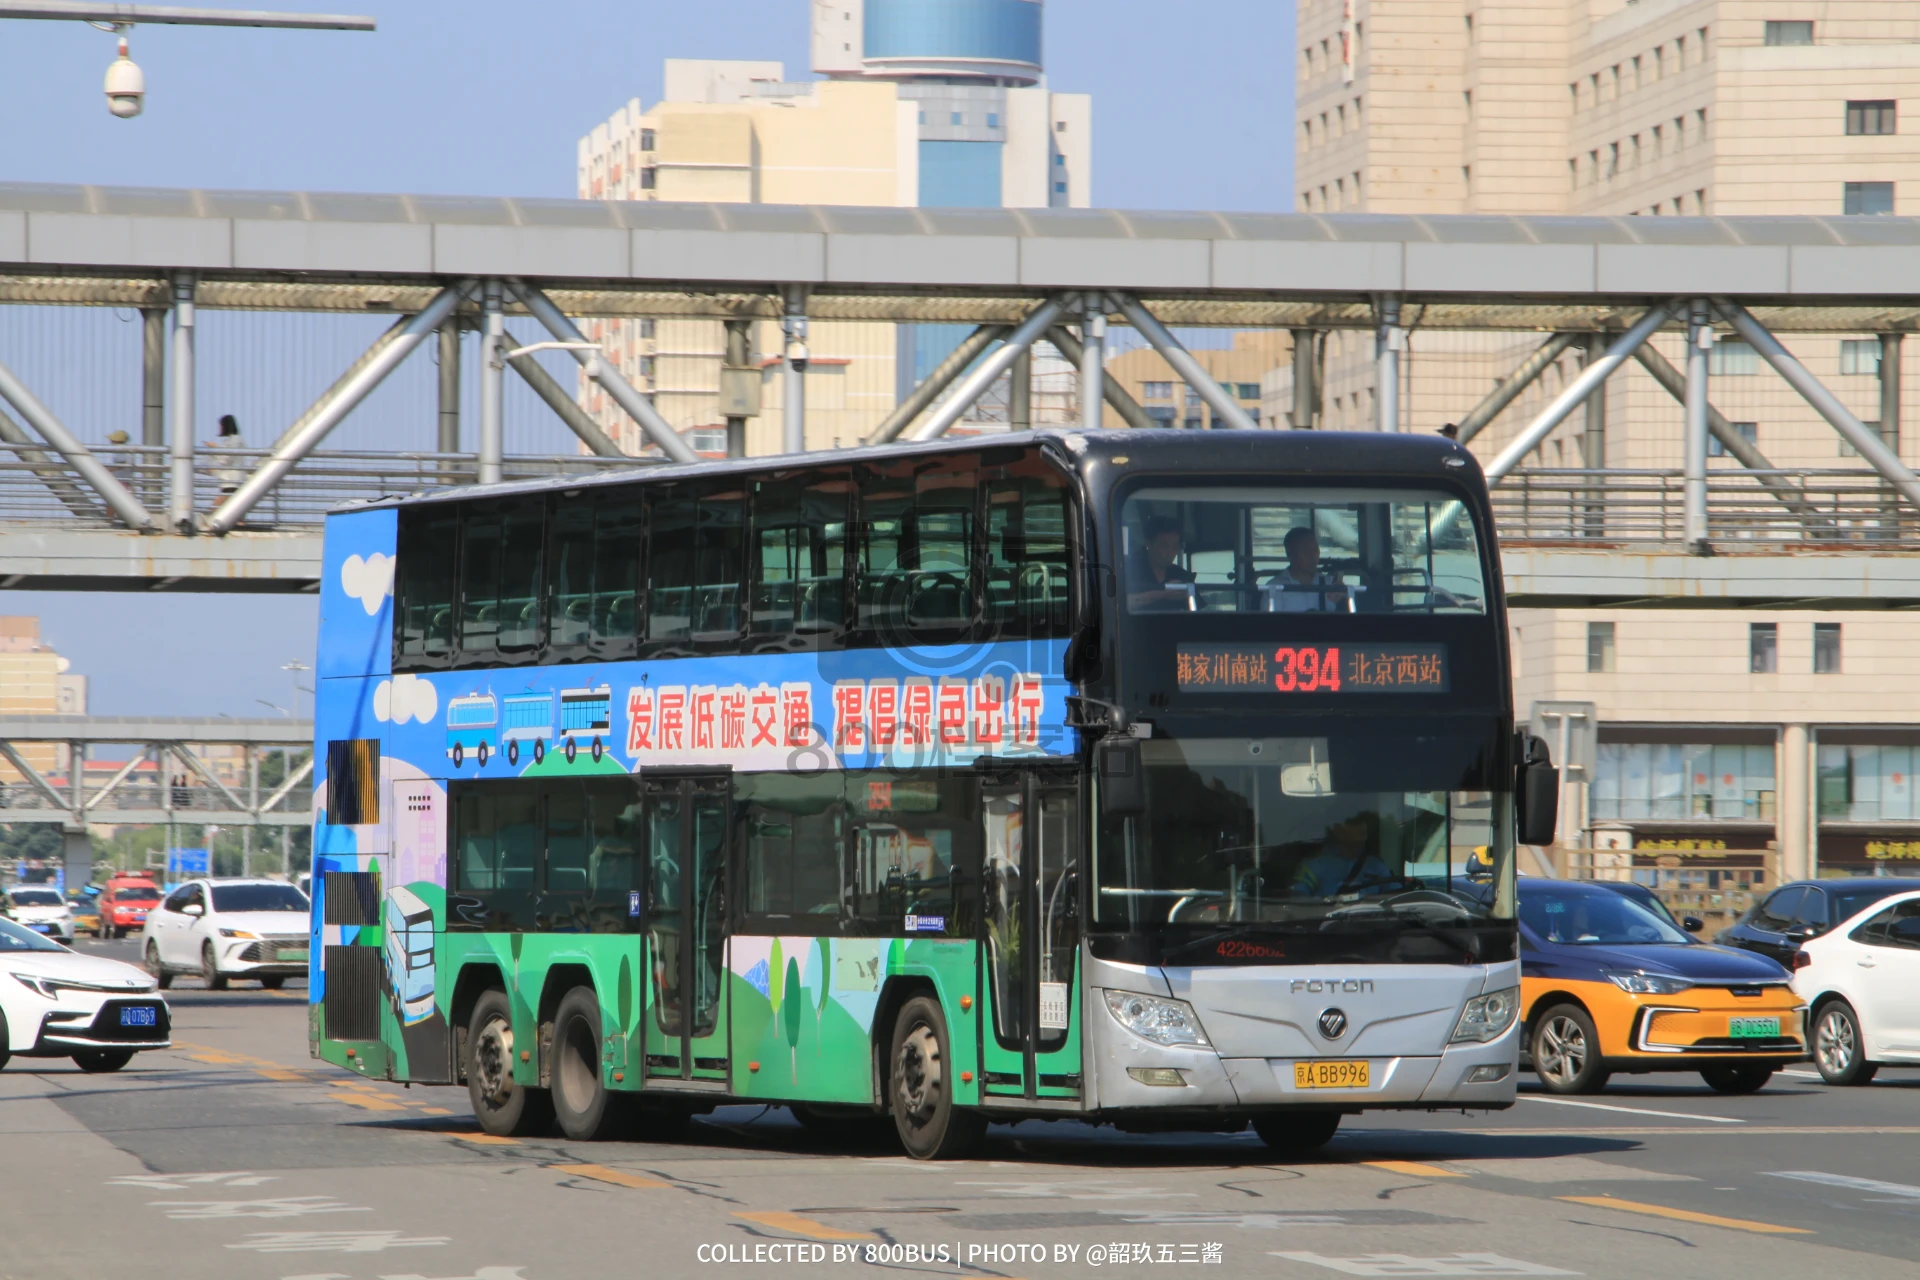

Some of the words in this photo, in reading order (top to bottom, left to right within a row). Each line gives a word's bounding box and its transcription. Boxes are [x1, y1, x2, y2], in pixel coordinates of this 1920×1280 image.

[1274, 647, 1342, 692] 394
[1348, 652, 1443, 686] 北京西站
[627, 684, 812, 753] 发展低碳交通
[834, 676, 1044, 750] 提倡绿色出行
[1289, 979, 1375, 994] FOTON
